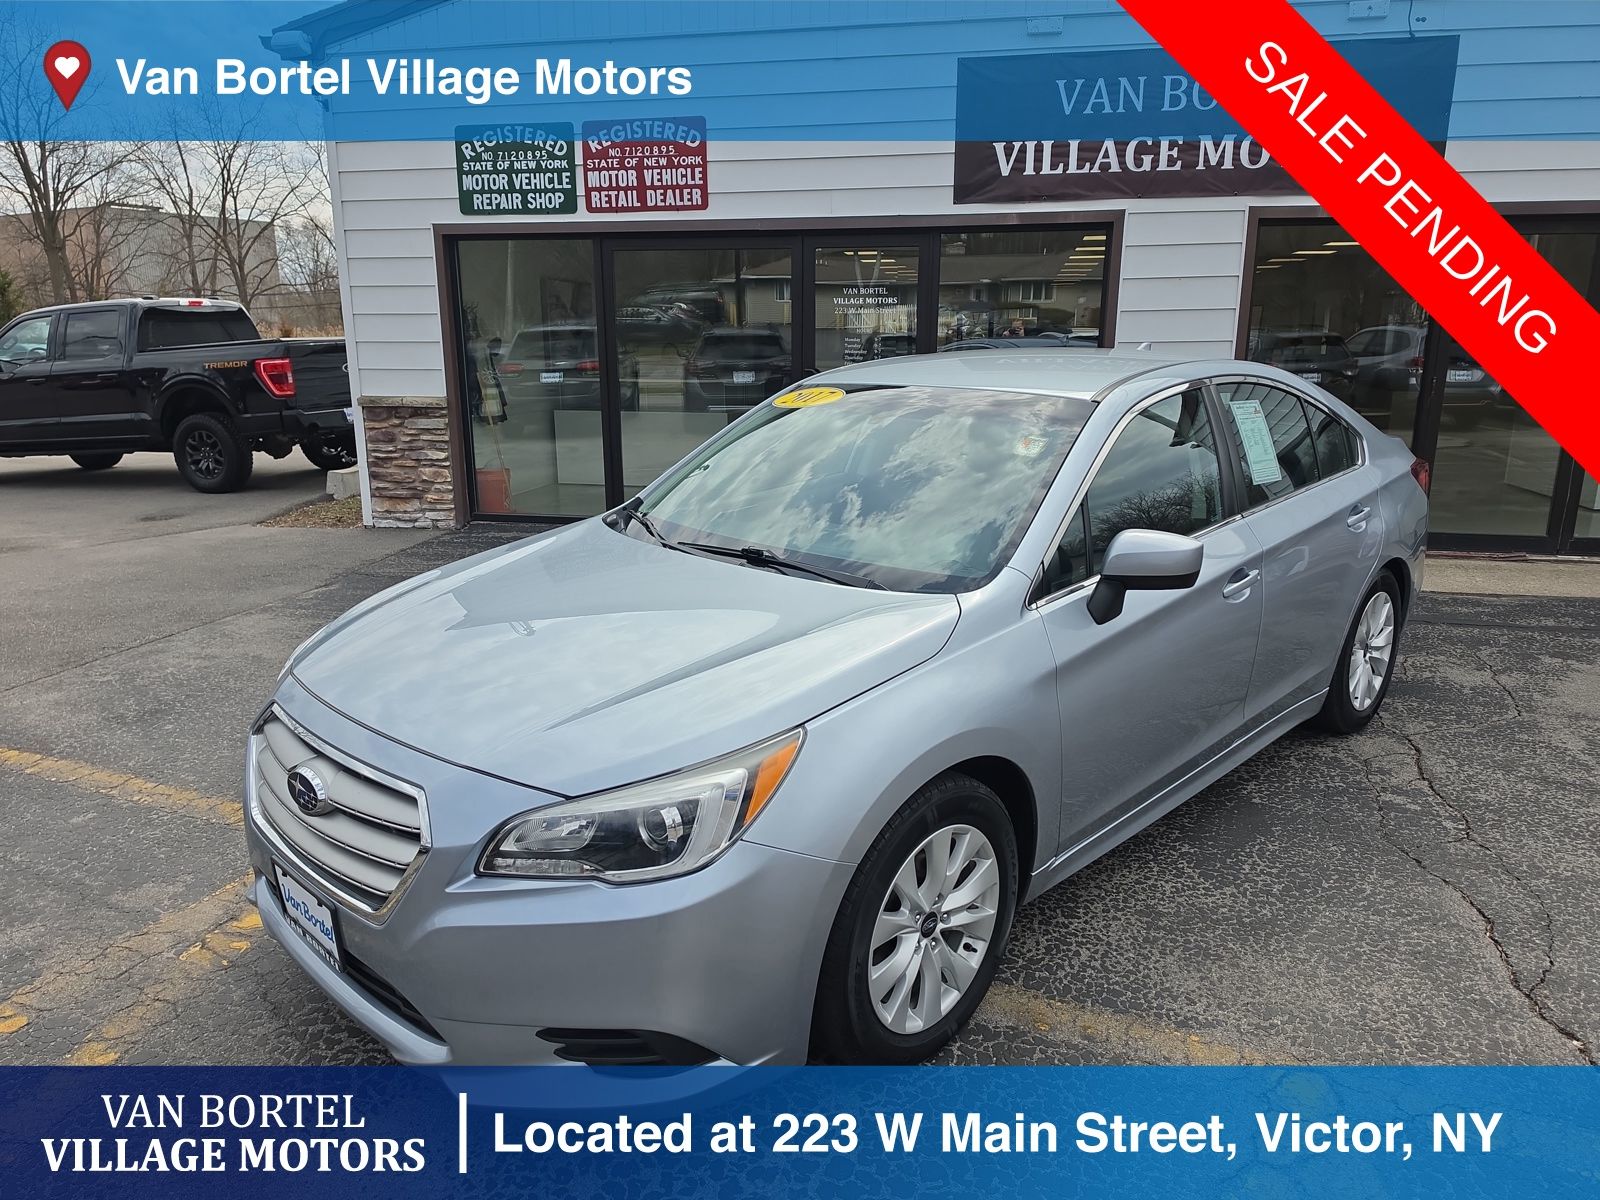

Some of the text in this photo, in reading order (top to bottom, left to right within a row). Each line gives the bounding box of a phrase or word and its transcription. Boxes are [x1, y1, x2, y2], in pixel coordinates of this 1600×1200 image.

[1056, 76, 1148, 115] VAN
[460, 125, 568, 160] REGISTERED
[587, 120, 701, 153] REGISTERED
[497, 150, 548, 160] 7120895
[624, 145, 675, 156] 7120895
[992, 135, 1184, 177] VILLAGE
[462, 159, 569, 171] STATE OF NEW YORK
[586, 155, 703, 168] STATE OF NEW YORK
[462, 172, 572, 191] MOTOR VEHICLE
[587, 167, 704, 188] MOTOR VEHICLE
[473, 193, 565, 210] REPAIR SHOP
[590, 188, 702, 208] RETAIL DEALER
[843, 287, 888, 295] VAN BORTEL
[833, 297, 864, 305] VILLAGE
[203, 360, 249, 370] TREMOR
